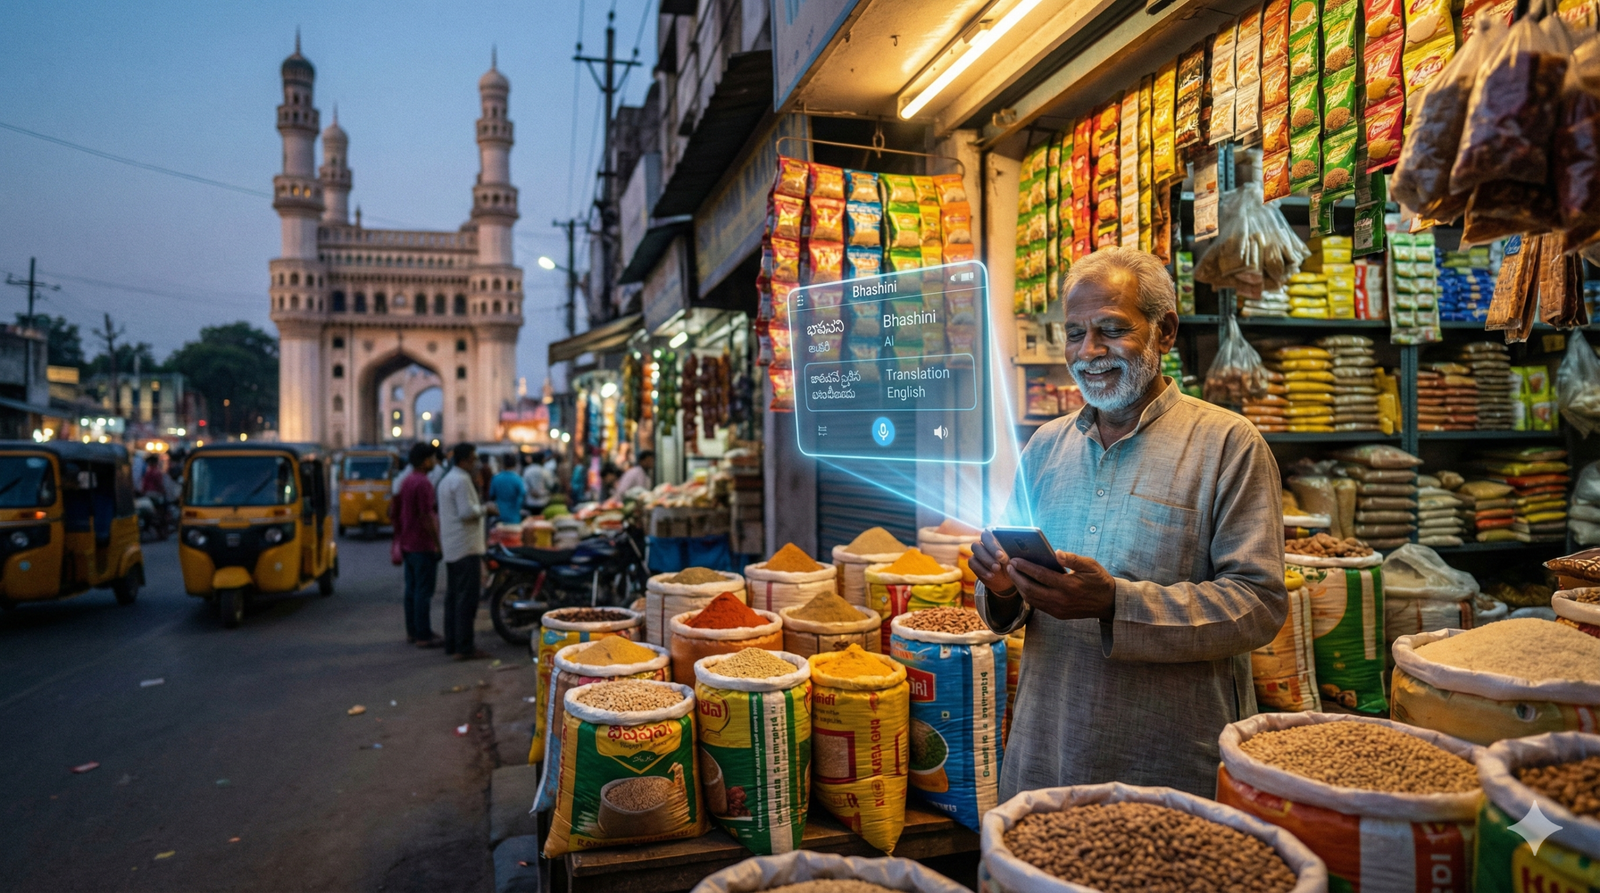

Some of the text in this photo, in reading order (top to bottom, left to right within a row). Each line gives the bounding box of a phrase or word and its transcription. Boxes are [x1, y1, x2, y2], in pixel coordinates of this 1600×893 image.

[853, 280, 897, 298] Bhashini
[883, 309, 936, 328] Bhashini
[884, 335, 894, 347] AI
[886, 366, 950, 381] Translation
[887, 385, 926, 401] English
